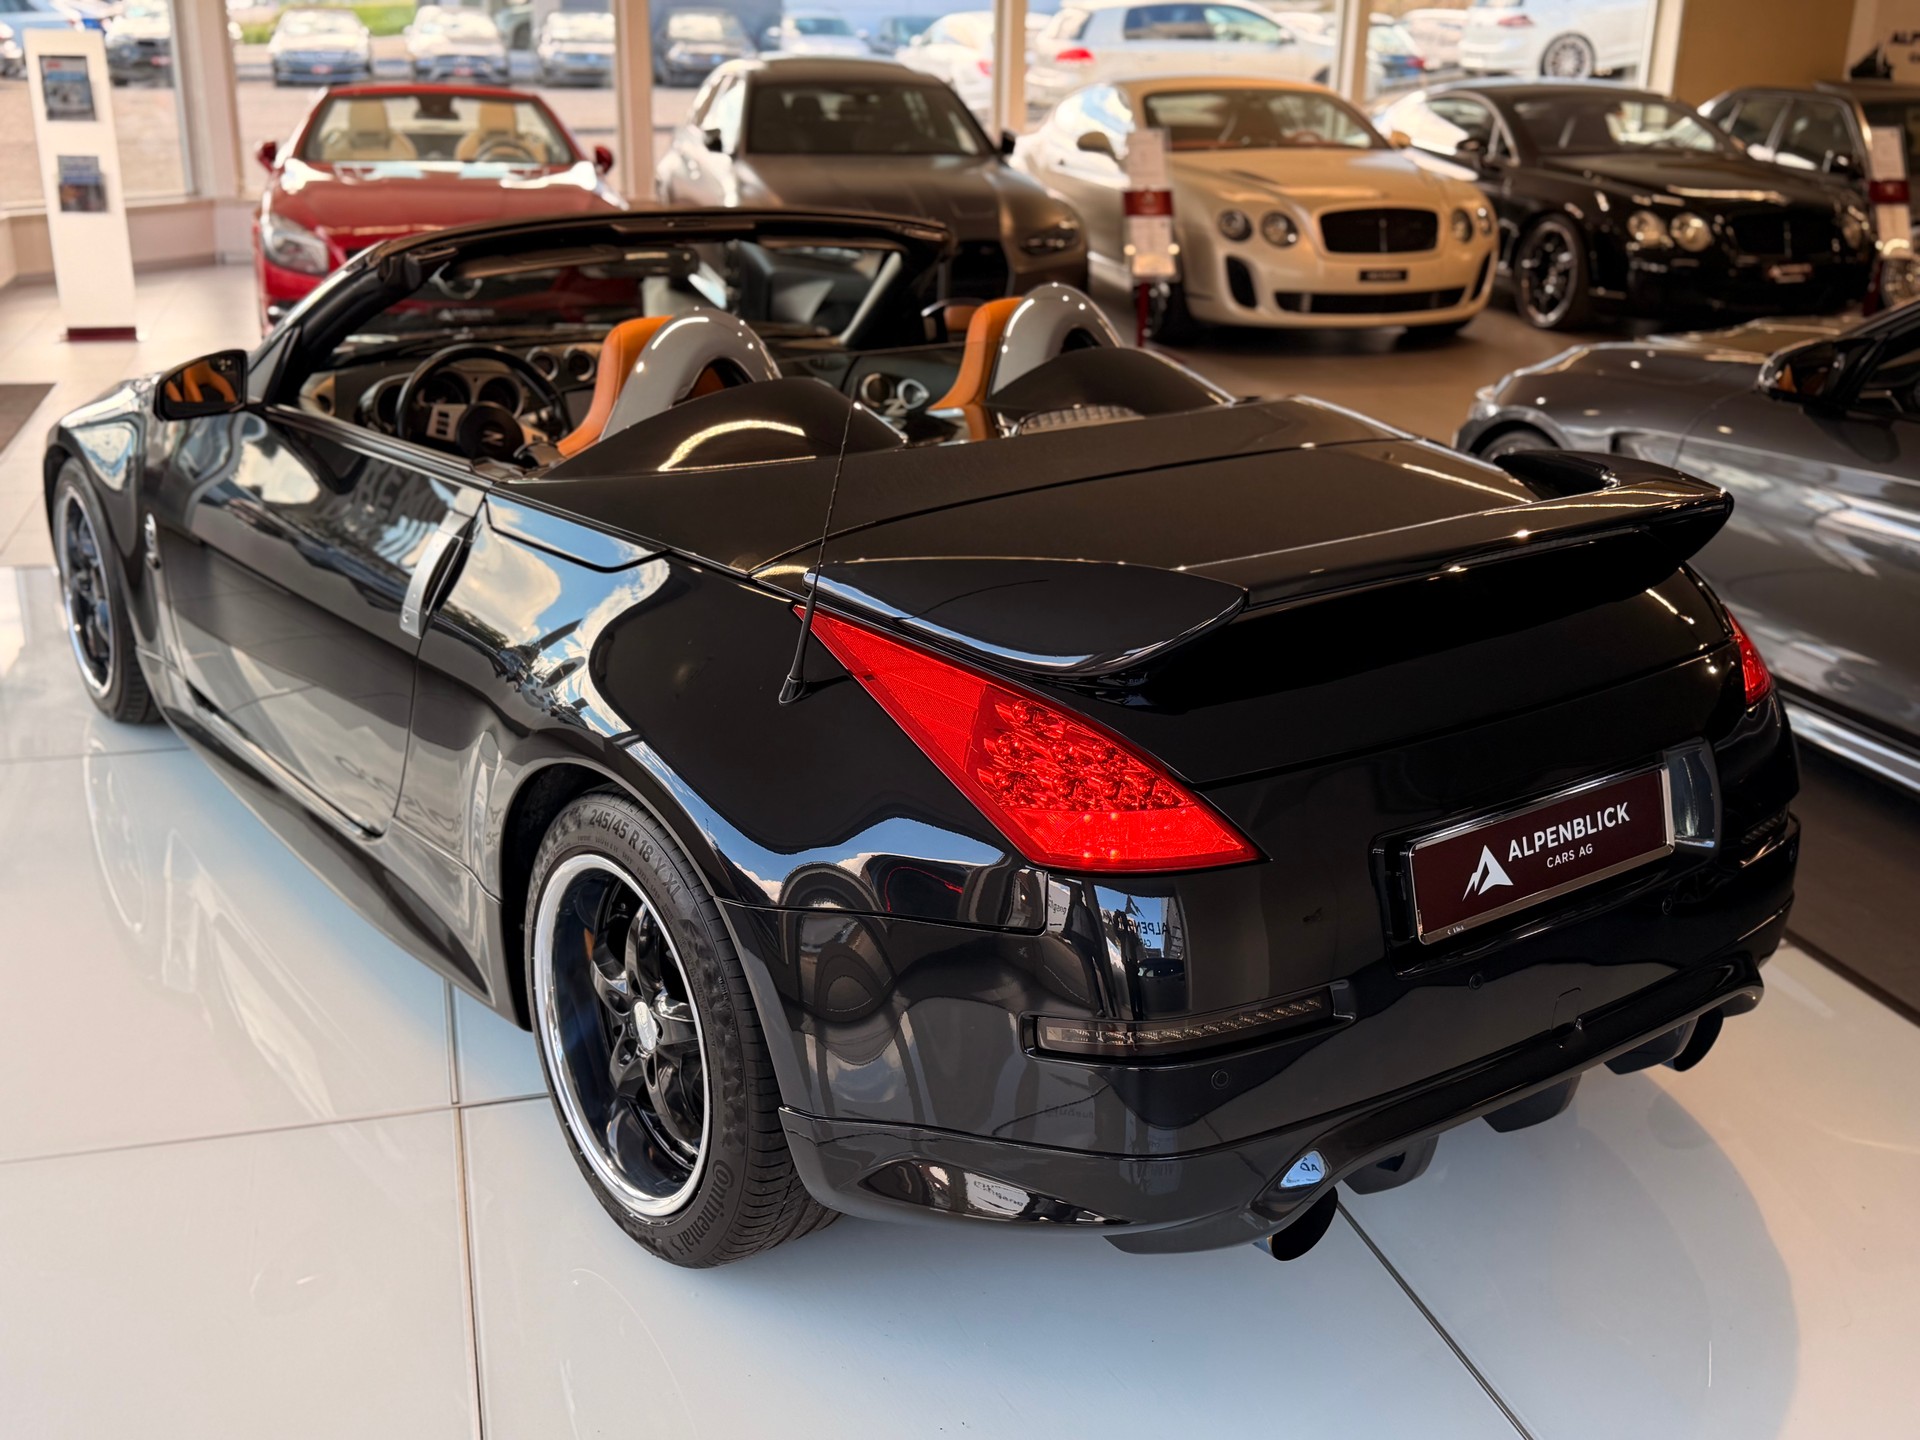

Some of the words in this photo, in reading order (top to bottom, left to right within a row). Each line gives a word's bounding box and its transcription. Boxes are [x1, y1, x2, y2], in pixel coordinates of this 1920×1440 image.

[589, 808, 629, 840] 245/45
[628, 828, 641, 850] R
[638, 840, 654, 863] 18
[653, 857, 667, 876] Y
[662, 872, 682, 904] XL
[1507, 802, 1630, 862] ALPENBLICK
[1546, 849, 1576, 869] CARS
[1578, 843, 1594, 856] AG
[677, 1159, 735, 1253] Continental
